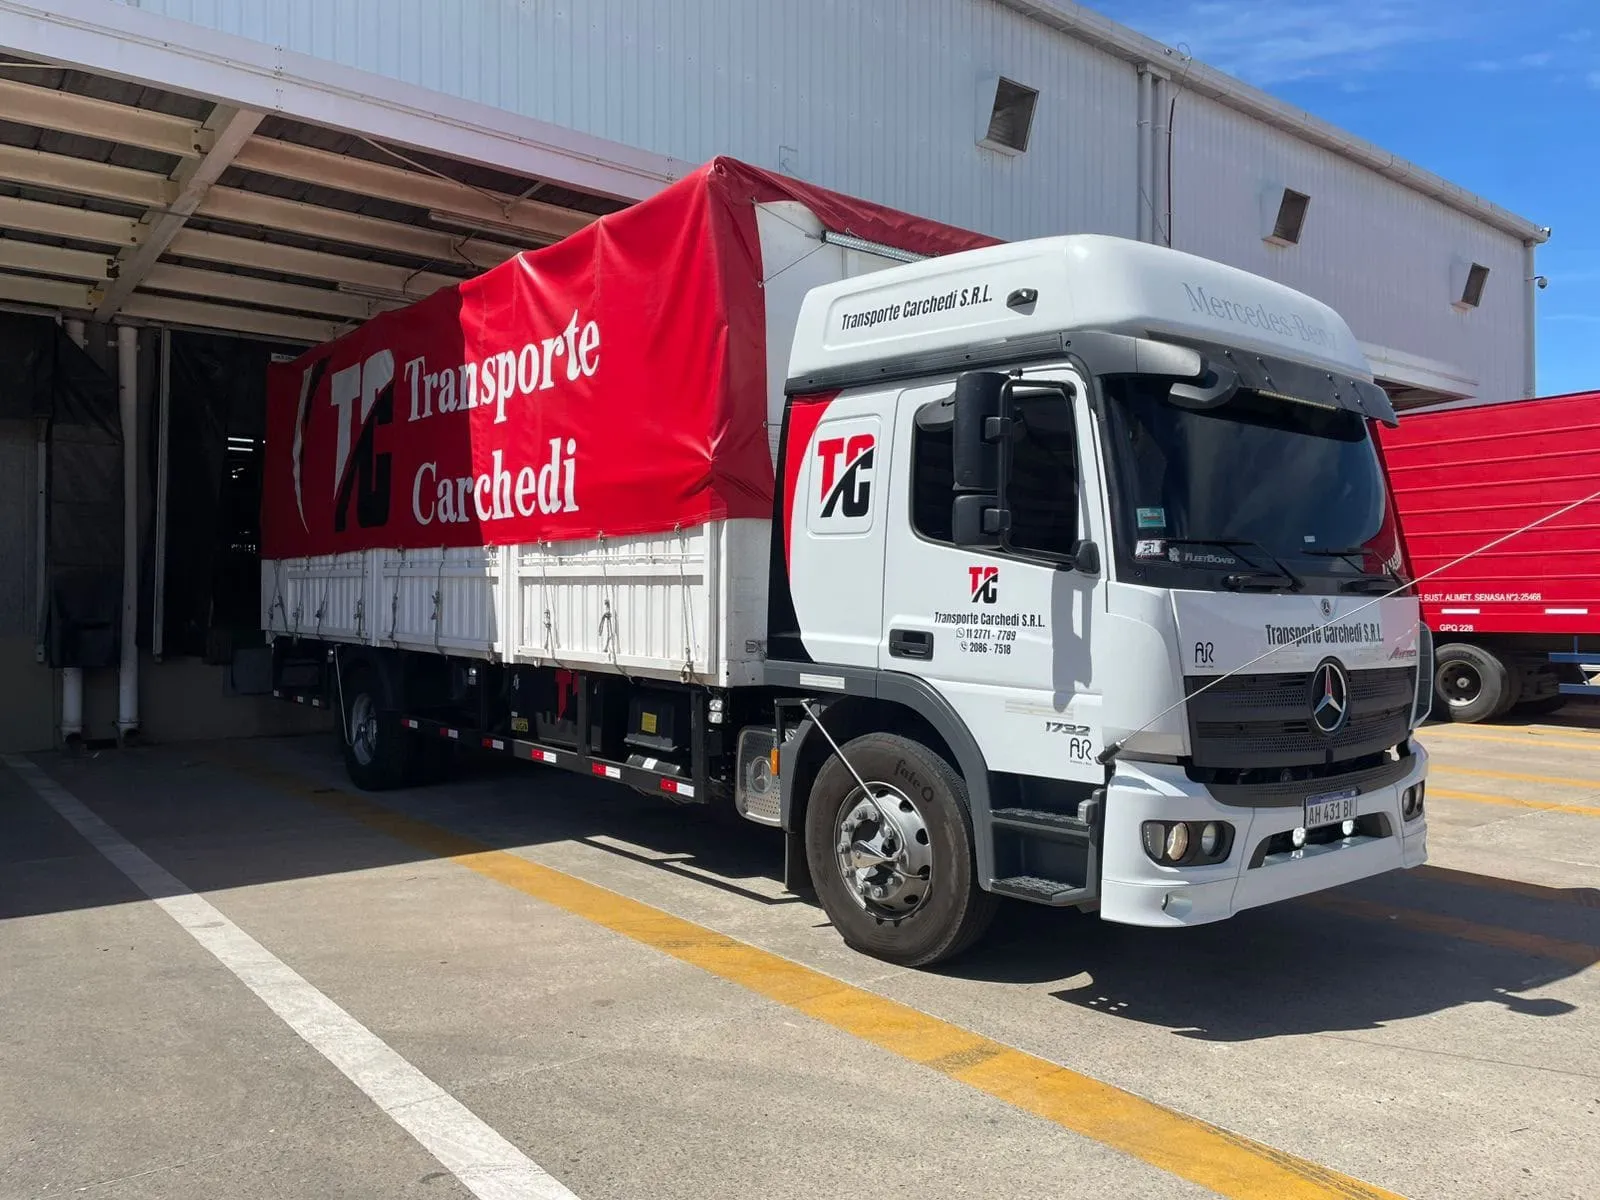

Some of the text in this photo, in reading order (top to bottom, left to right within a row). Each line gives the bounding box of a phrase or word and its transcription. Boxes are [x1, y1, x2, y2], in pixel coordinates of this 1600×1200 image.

[841, 284, 993, 331] Transporte Carchedi S.R.L.
[404, 308, 600, 424] Transporte
[412, 438, 579, 526] Carchedi
[934, 611, 1046, 628] Transporte Carchedi S.R.L.
[1265, 622, 1384, 647] Transporte Carchedi S.R.L.
[1309, 806, 1321, 825] AH
[1324, 801, 1341, 821] 431
